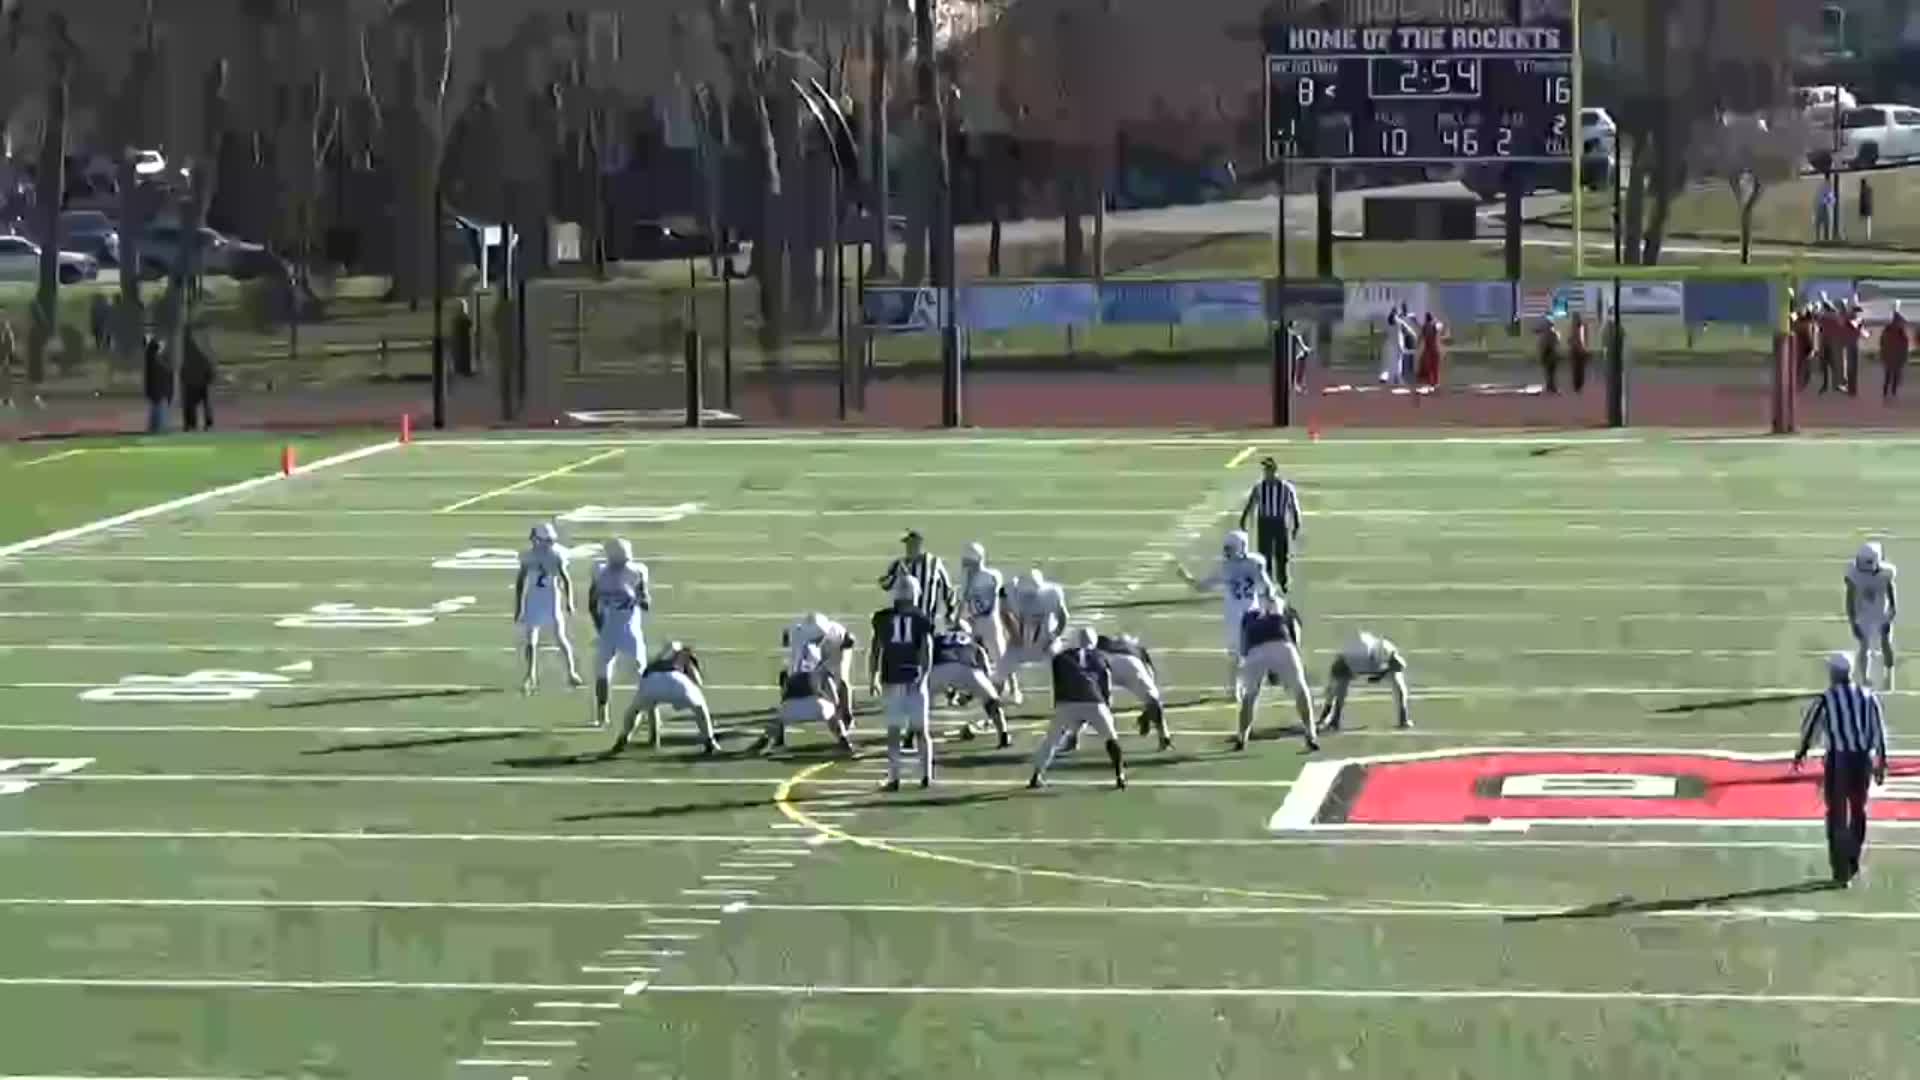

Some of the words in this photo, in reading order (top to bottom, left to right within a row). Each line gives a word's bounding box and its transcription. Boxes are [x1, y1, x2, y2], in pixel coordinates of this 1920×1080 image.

[1289, 28, 1357, 49] HOME
[1397, 28, 1446, 49] THE
[1452, 28, 1561, 49] ROCKETS
[1400, 59, 1476, 93] 2:54
[1298, 77, 1314, 106] 8
[1545, 77, 1571, 104] 16
[1382, 128, 1408, 156] 10
[1443, 128, 1479, 156] 46
[1496, 127, 1512, 155] 2
[893, 616, 913, 643] 11
